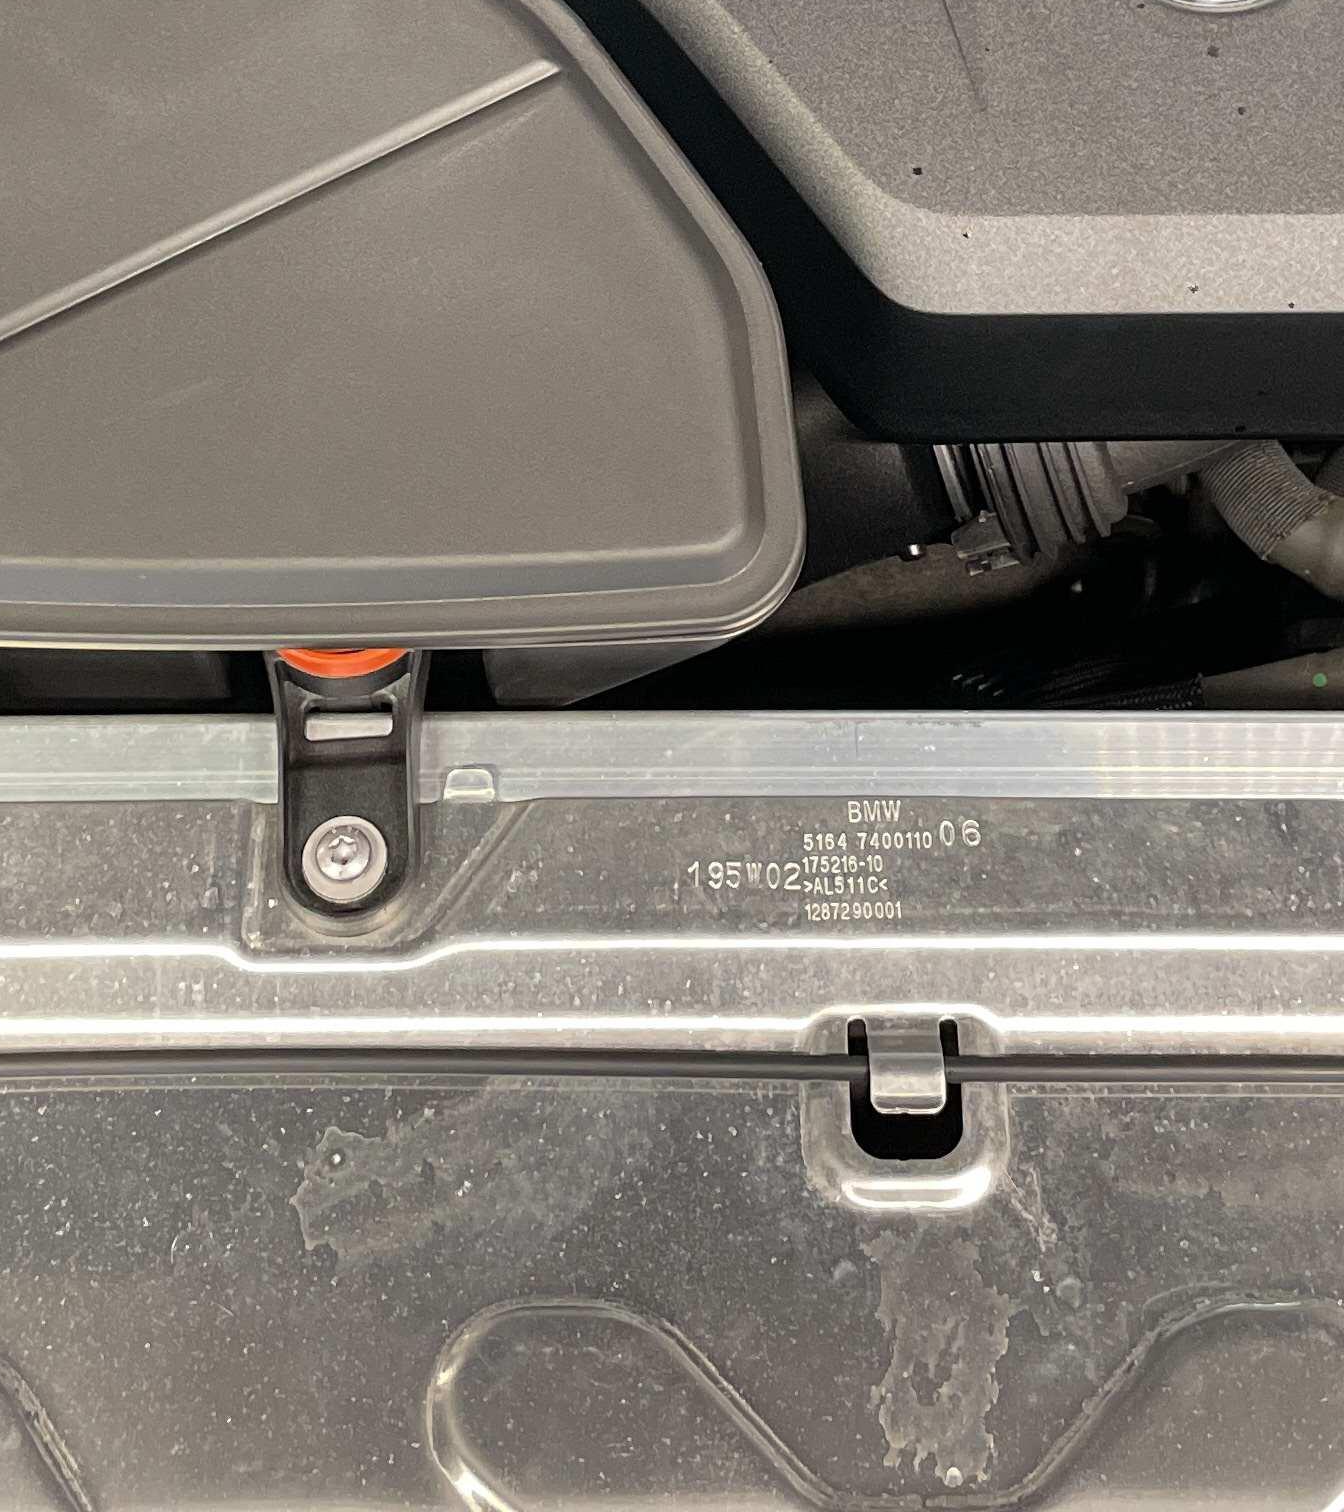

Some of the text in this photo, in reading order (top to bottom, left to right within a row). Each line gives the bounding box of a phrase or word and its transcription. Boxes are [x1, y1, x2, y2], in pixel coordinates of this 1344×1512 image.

[847, 800, 901, 823] BMW
[803, 820, 981, 851] 5164 7400110 06
[802, 854, 884, 873] 175216-10
[805, 901, 902, 921] 1287290001
